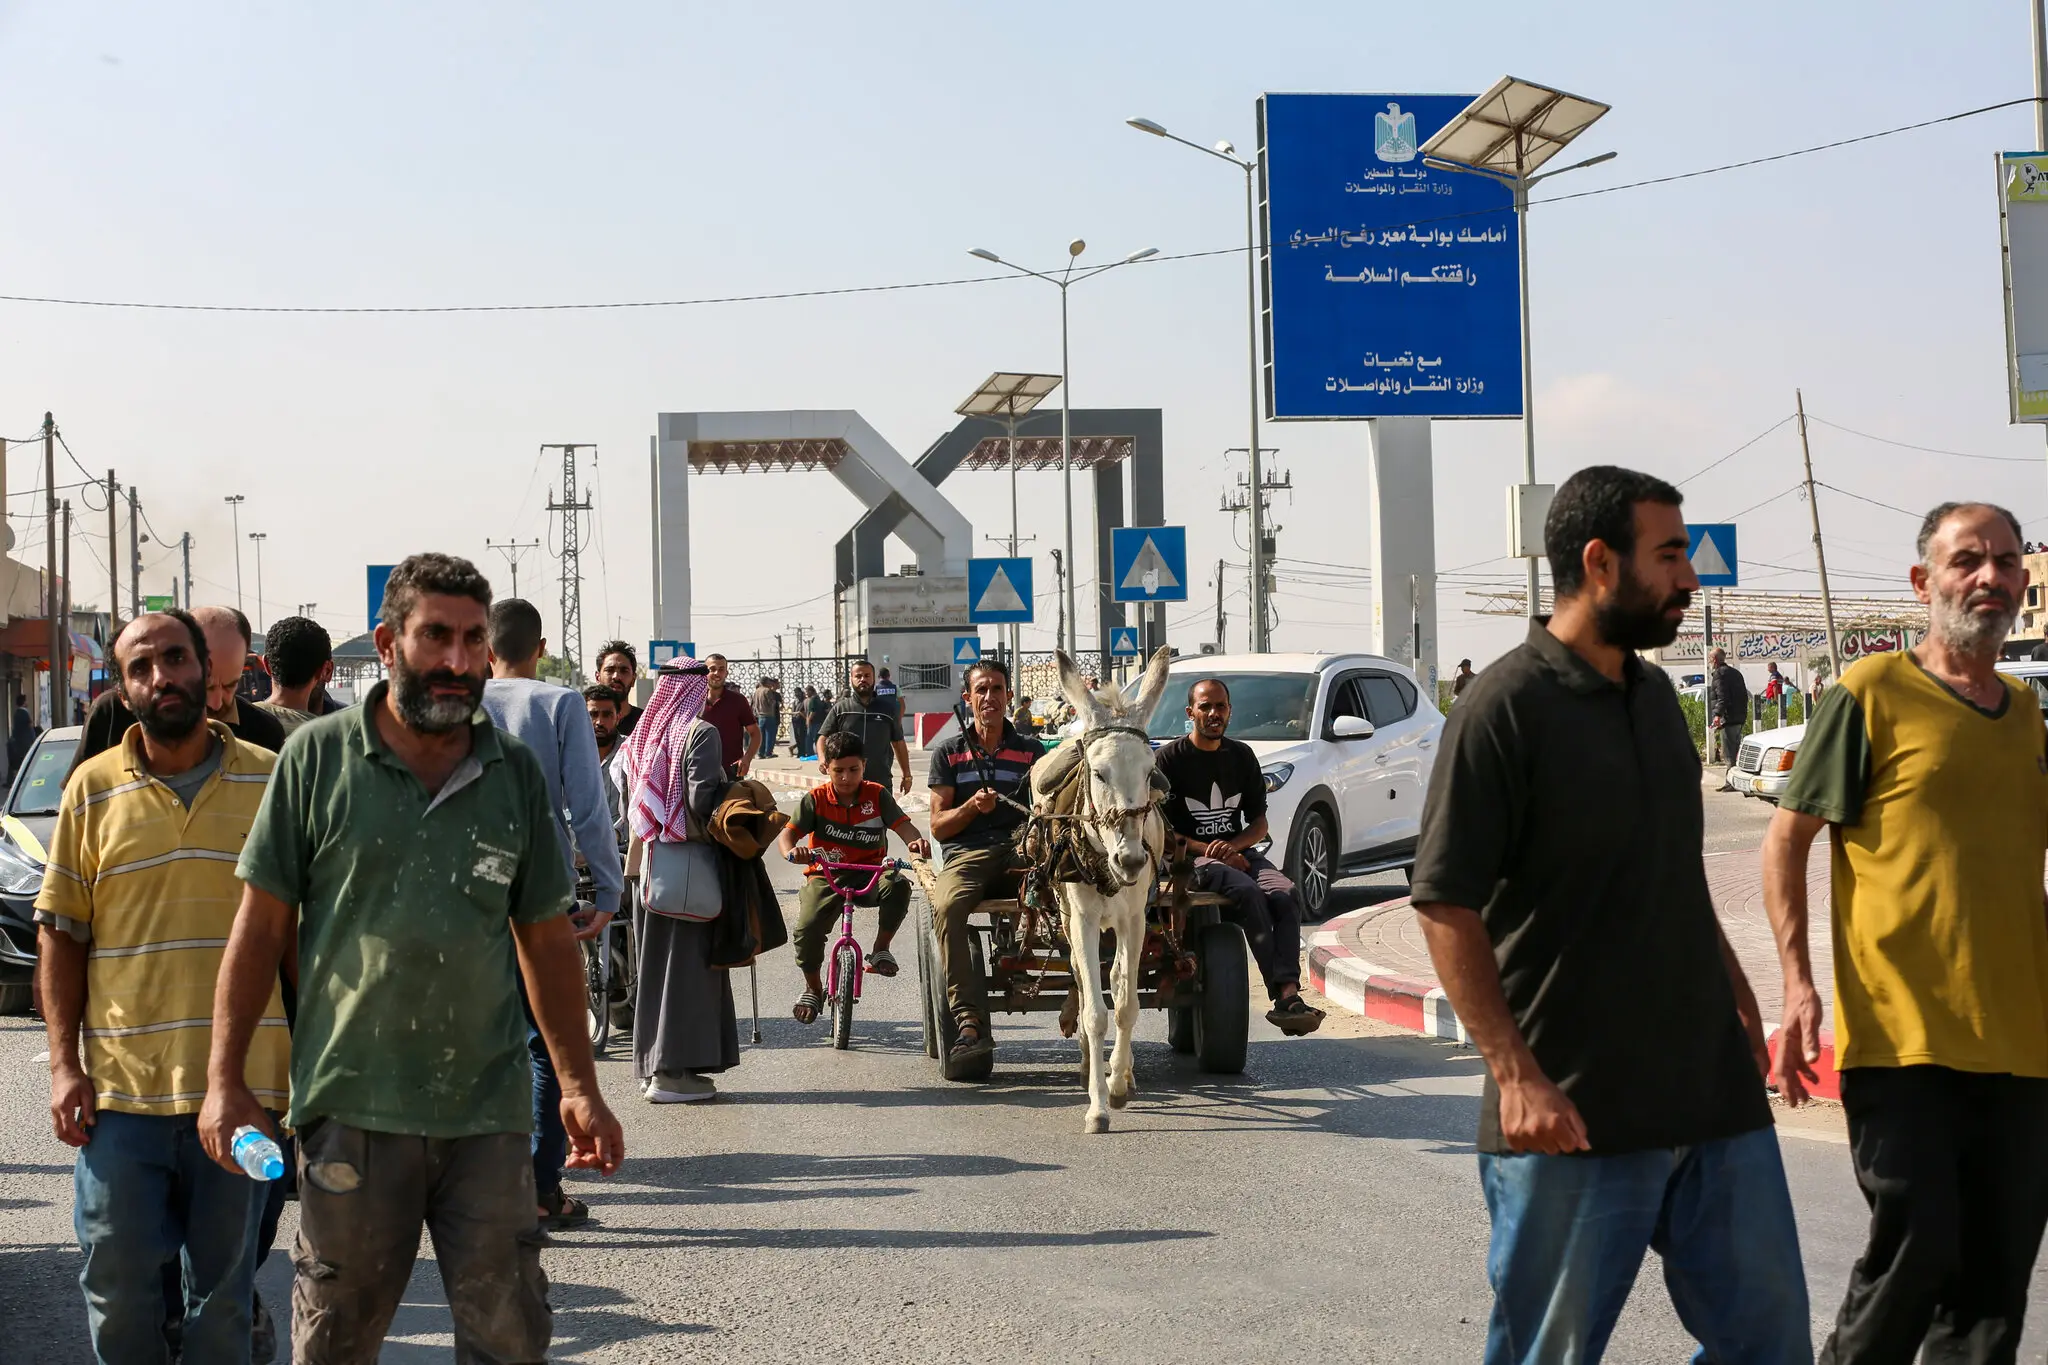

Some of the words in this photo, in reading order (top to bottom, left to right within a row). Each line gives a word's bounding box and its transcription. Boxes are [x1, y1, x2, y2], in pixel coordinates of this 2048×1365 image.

[1364, 166, 1394, 179] فلسطين
[1398, 167, 1427, 180] دولة
[1346, 183, 1395, 195] والمواصلات
[1399, 183, 1430, 194] النقل
[1433, 183, 1452, 194] وزارة
[1290, 228, 1337, 248] البري
[1341, 224, 1374, 247] رفح
[1378, 232, 1406, 246] معبر
[1408, 225, 1453, 247] بوابة
[1457, 225, 1507, 242] أمامك
[1325, 265, 1397, 283] السلامة
[1401, 264, 1476, 286] رافقتكم
[1364, 352, 1413, 372] تحيات
[1417, 356, 1441, 372] مع
[1326, 377, 1400, 395] والمواصلات
[1403, 376, 1451, 394] النقل
[1456, 378, 1483, 394] وزارة
[824, 824, 855, 841] Detroit
